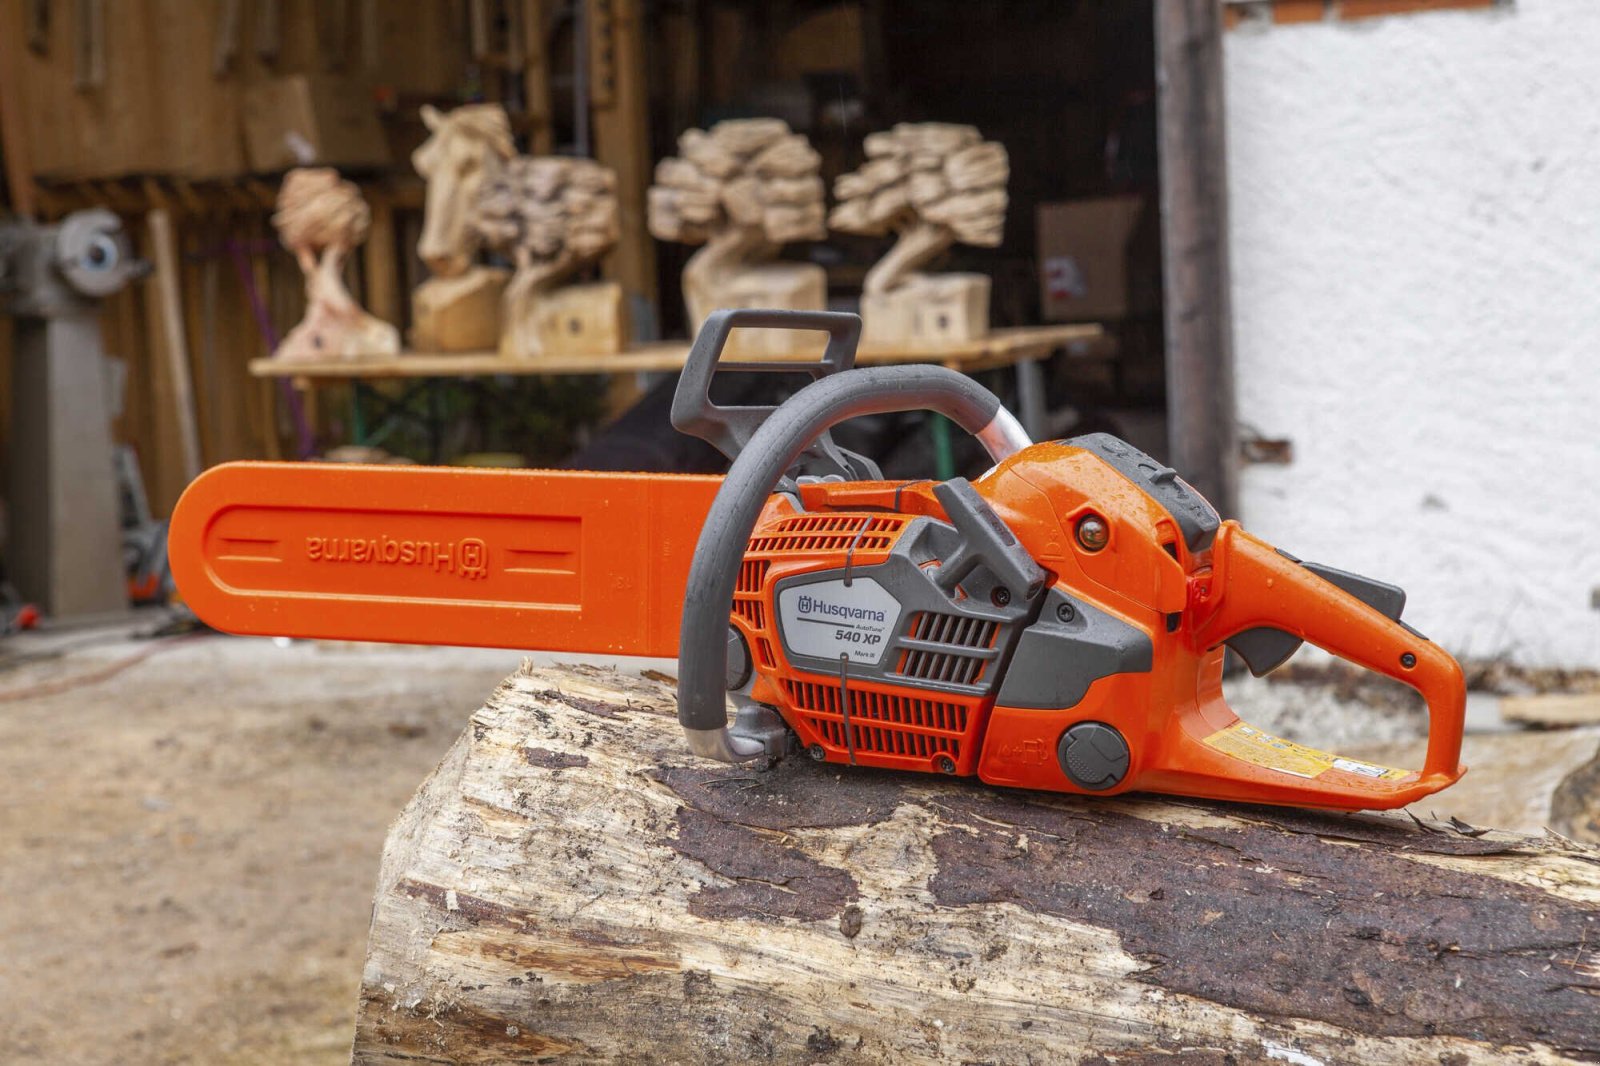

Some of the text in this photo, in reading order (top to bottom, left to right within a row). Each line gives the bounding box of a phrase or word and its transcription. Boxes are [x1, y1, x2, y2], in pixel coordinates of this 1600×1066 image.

[305, 535, 455, 573] Husqvarna
[813, 600, 885, 622] Husqvarna
[835, 630, 881, 645] 540 XP
